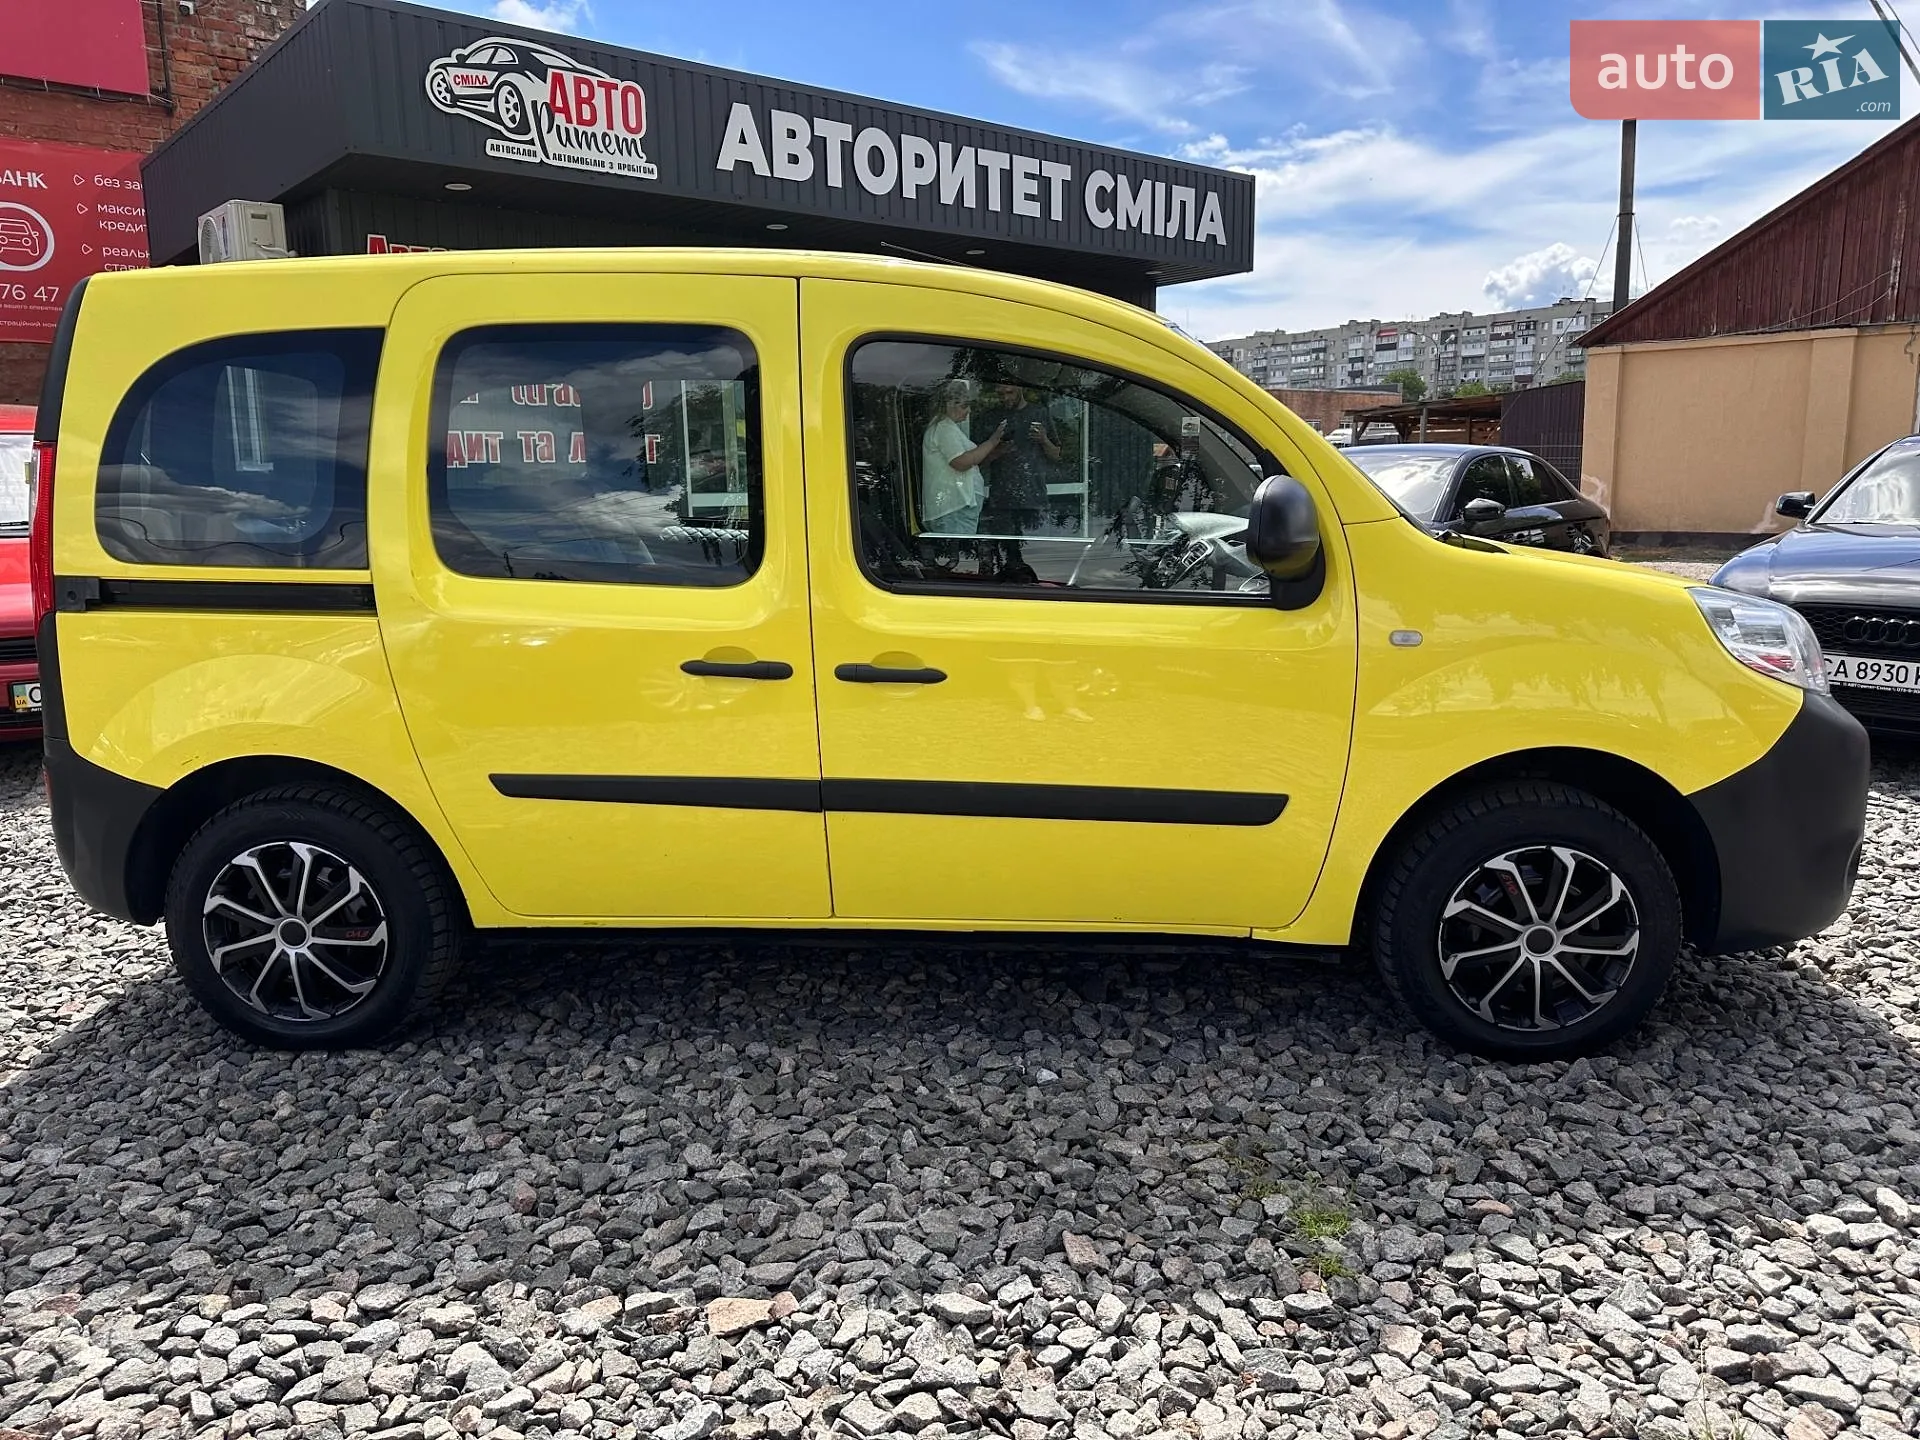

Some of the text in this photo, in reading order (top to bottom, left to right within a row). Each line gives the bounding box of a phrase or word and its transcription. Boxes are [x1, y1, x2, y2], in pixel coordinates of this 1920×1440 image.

[453, 73, 489, 87] СМІЛА
[549, 71, 644, 135] АВТО
[490, 143, 538, 159] АВТОСАЛОН
[552, 152, 606, 169] АВТОМОБІЛІВ
[617, 162, 655, 176] ПРОБІГОМ
[0, 169, 48, 190] АНК
[94, 174, 120, 189] без
[716, 102, 1227, 246] АВТОРИТЕТ СМІЛА
[33, 286, 60, 302] 47
[1856, 661, 1909, 684] 8930
